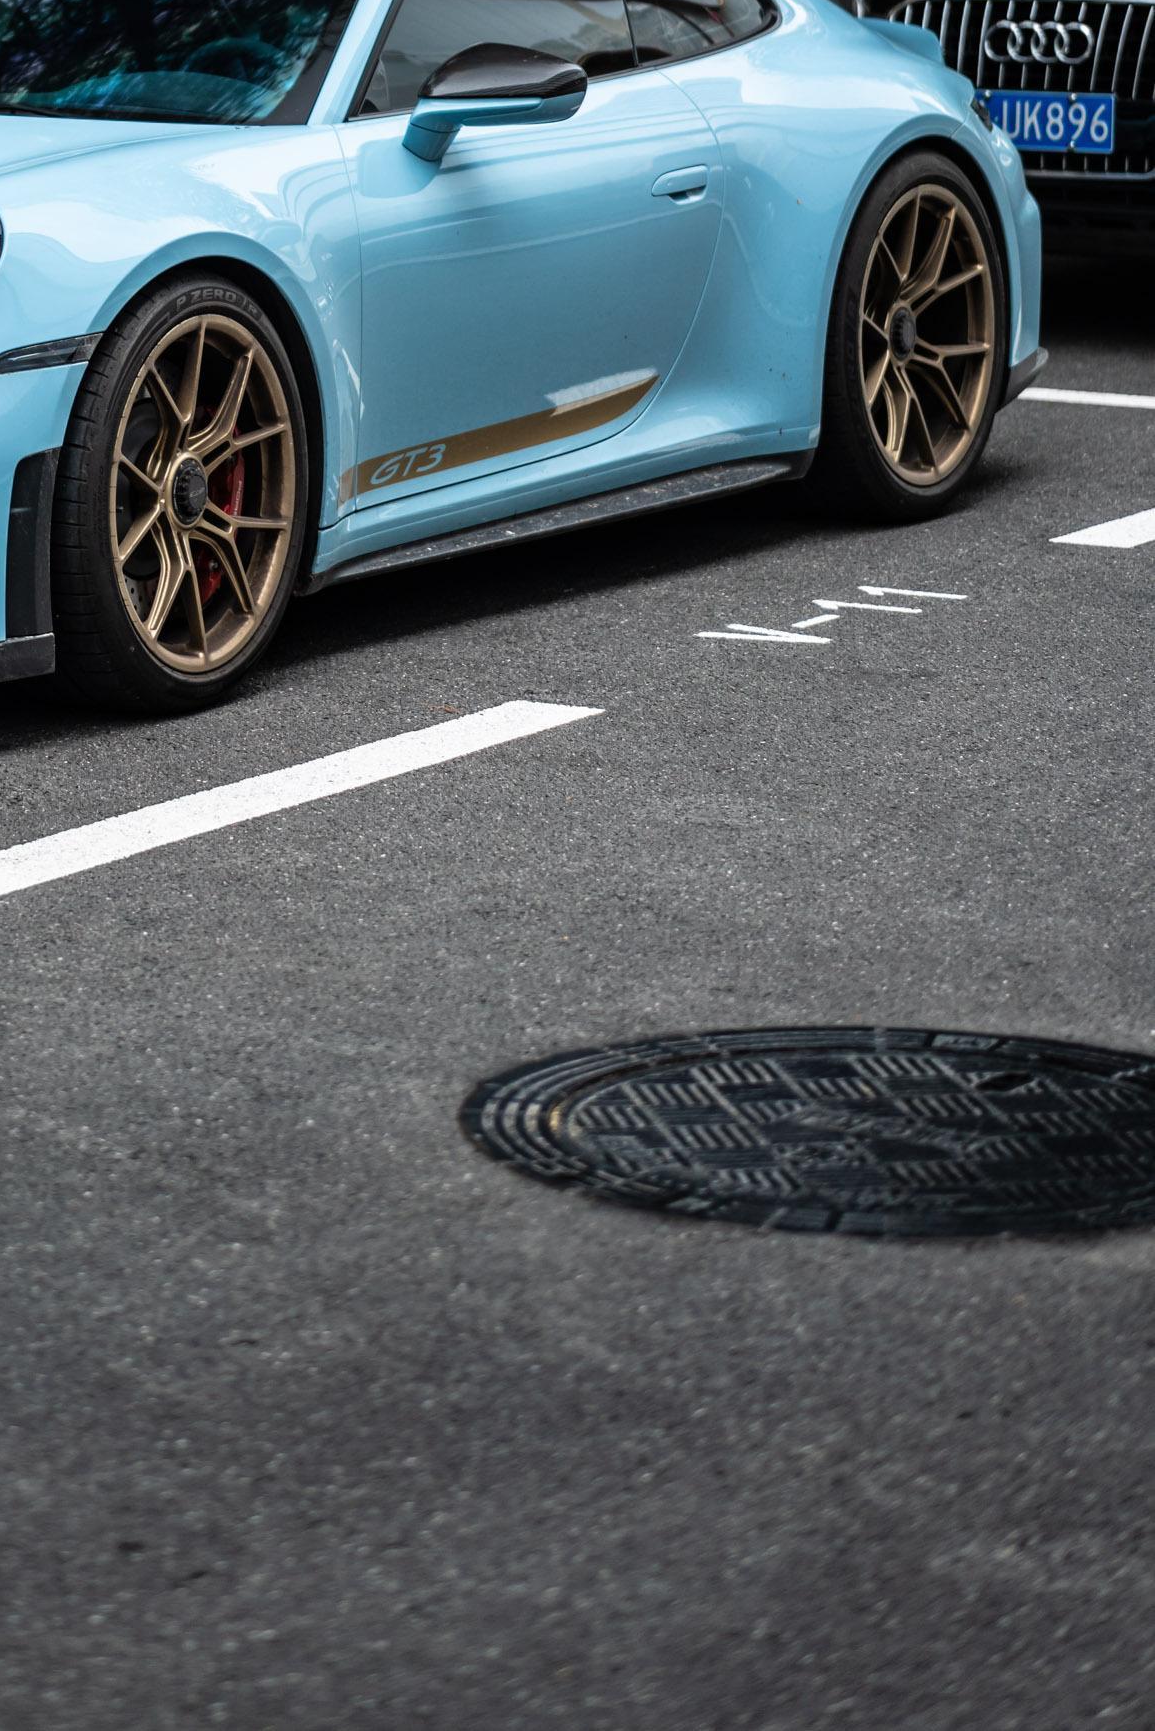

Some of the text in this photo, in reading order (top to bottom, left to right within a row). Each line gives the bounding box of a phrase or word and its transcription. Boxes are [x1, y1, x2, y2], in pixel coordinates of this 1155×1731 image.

[176, 294, 186, 311] P
[190, 288, 237, 303] ZERO
[371, 444, 445, 485] GT3
